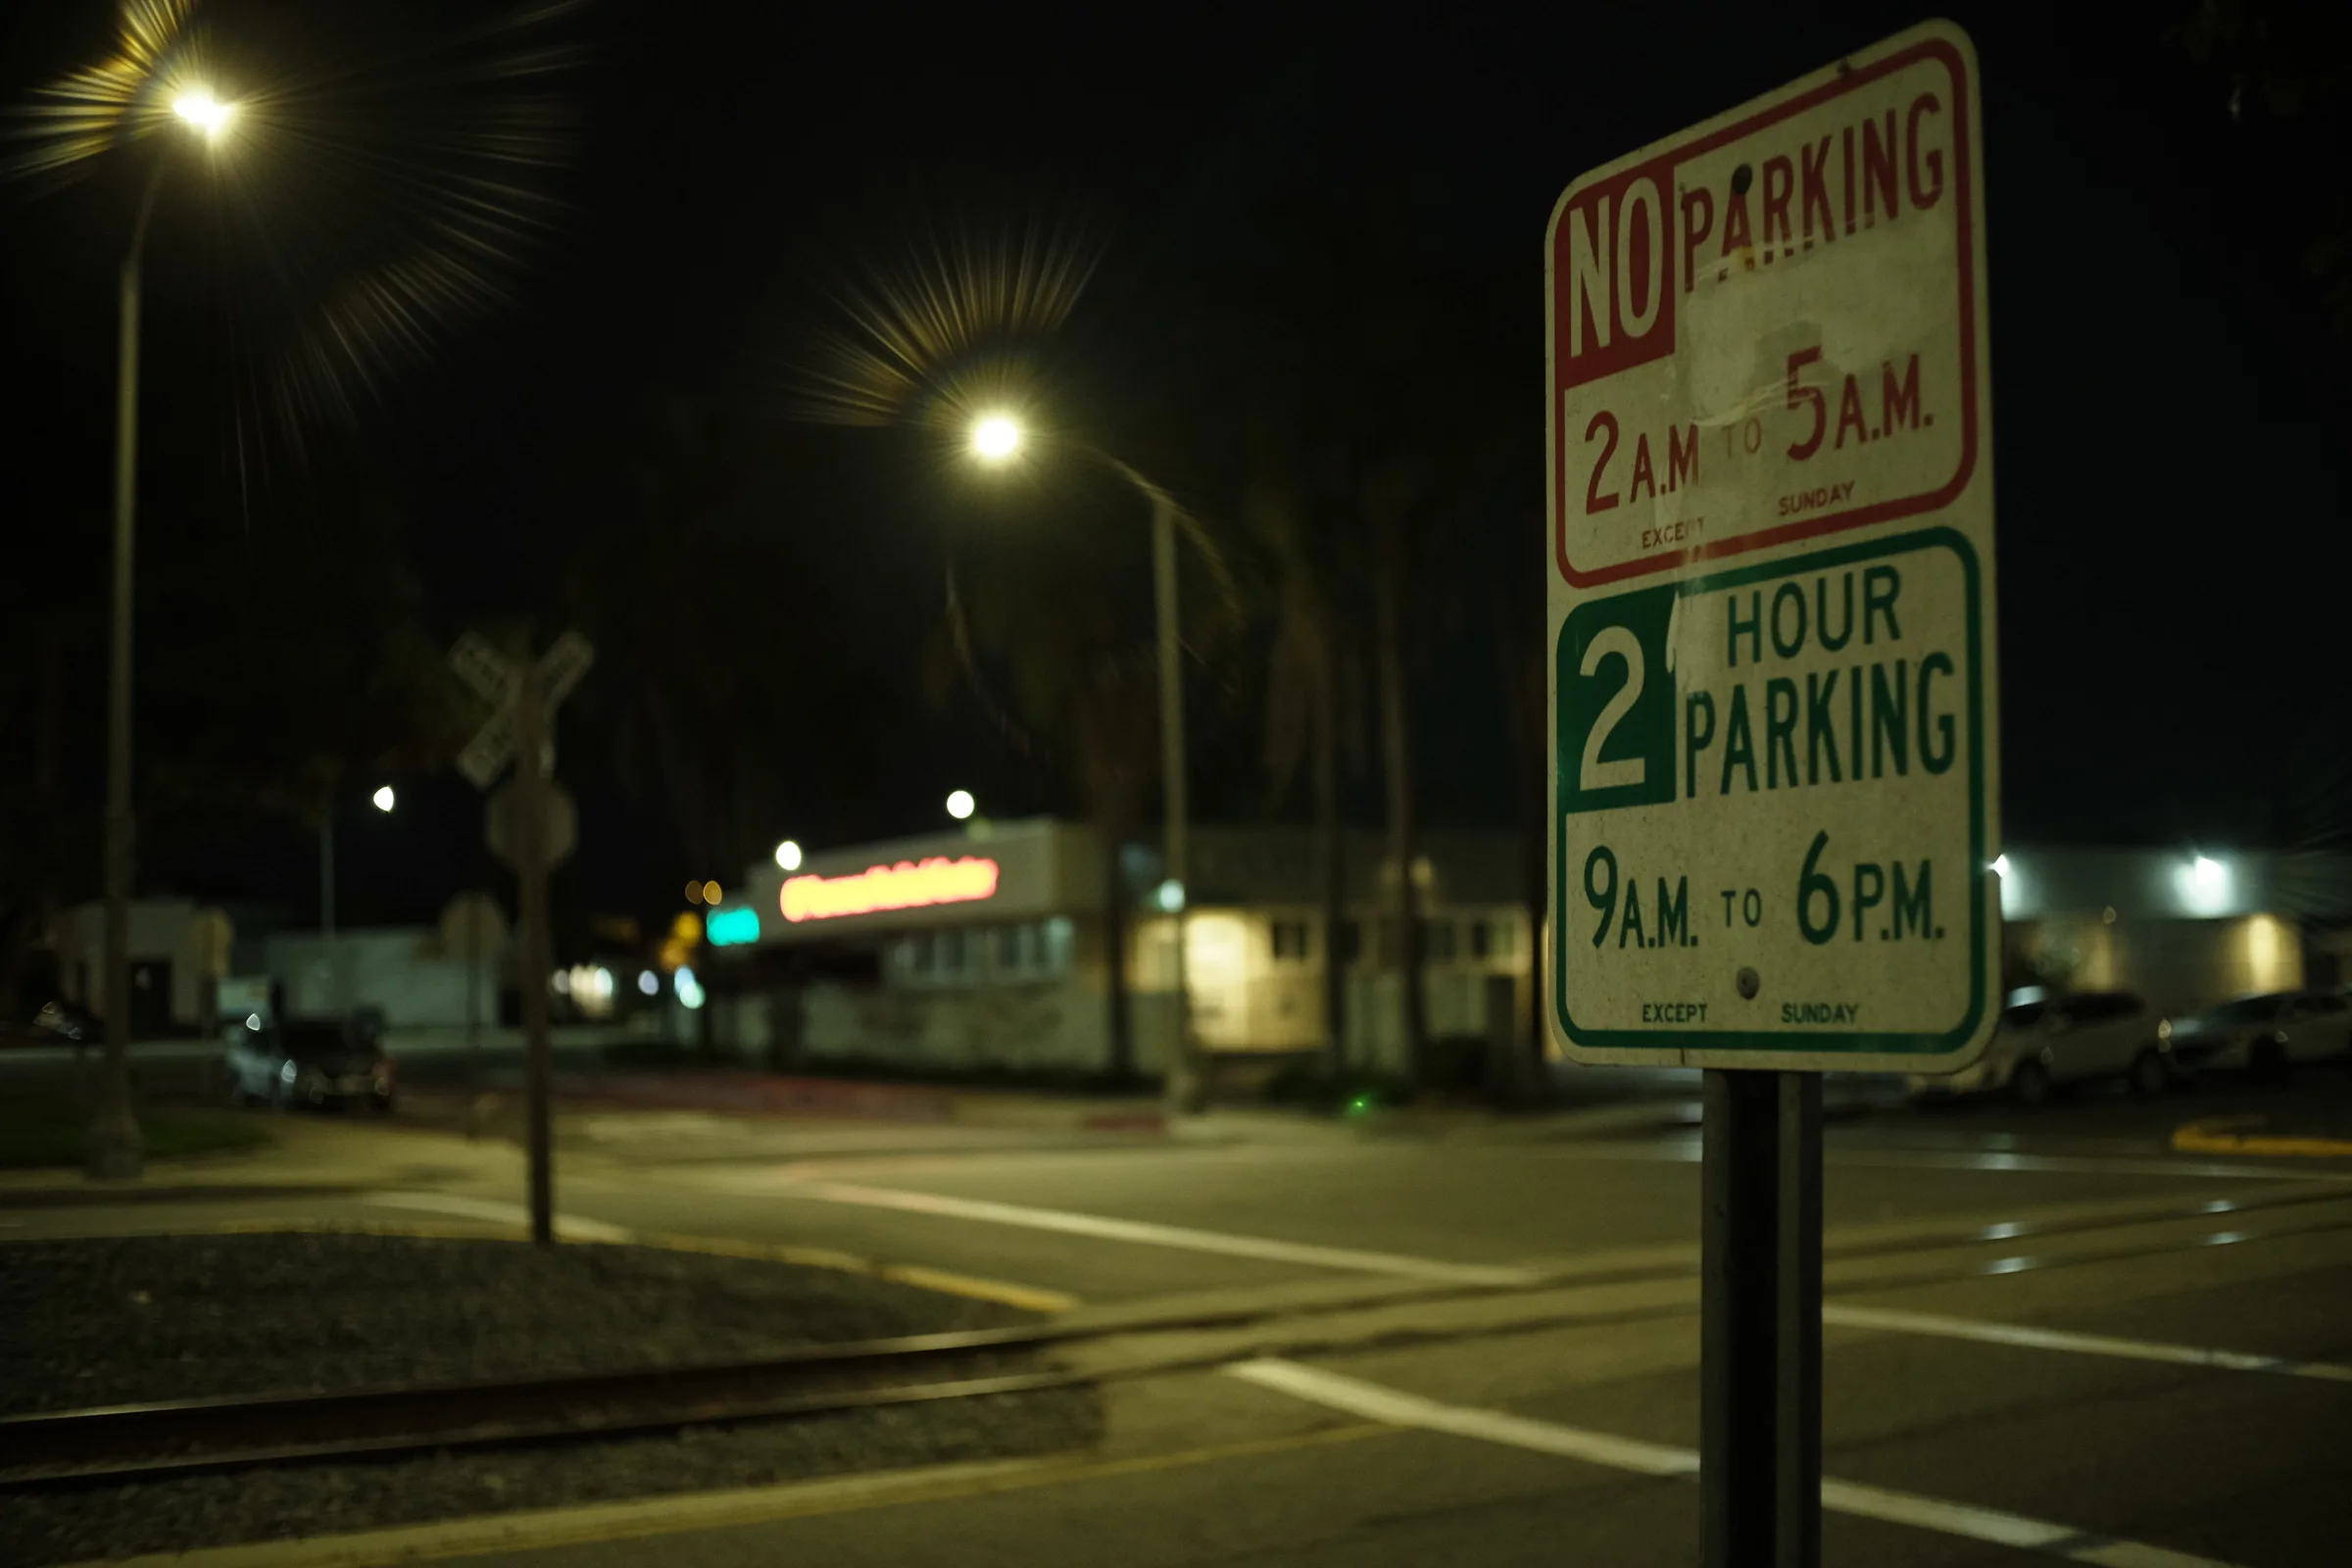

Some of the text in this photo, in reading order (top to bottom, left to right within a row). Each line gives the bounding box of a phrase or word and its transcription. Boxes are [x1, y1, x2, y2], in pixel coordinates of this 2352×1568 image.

[1570, 92, 1943, 359] NO PARKING
[1721, 417, 1762, 459] TO
[1778, 481, 1855, 515] SUNDAY
[1579, 564, 1901, 791] 2 HOUR
[1686, 651, 1955, 798] PARKING
[1722, 888, 1761, 927] TO
[1642, 1004, 1858, 1024] EXCEPT SUNDAY
